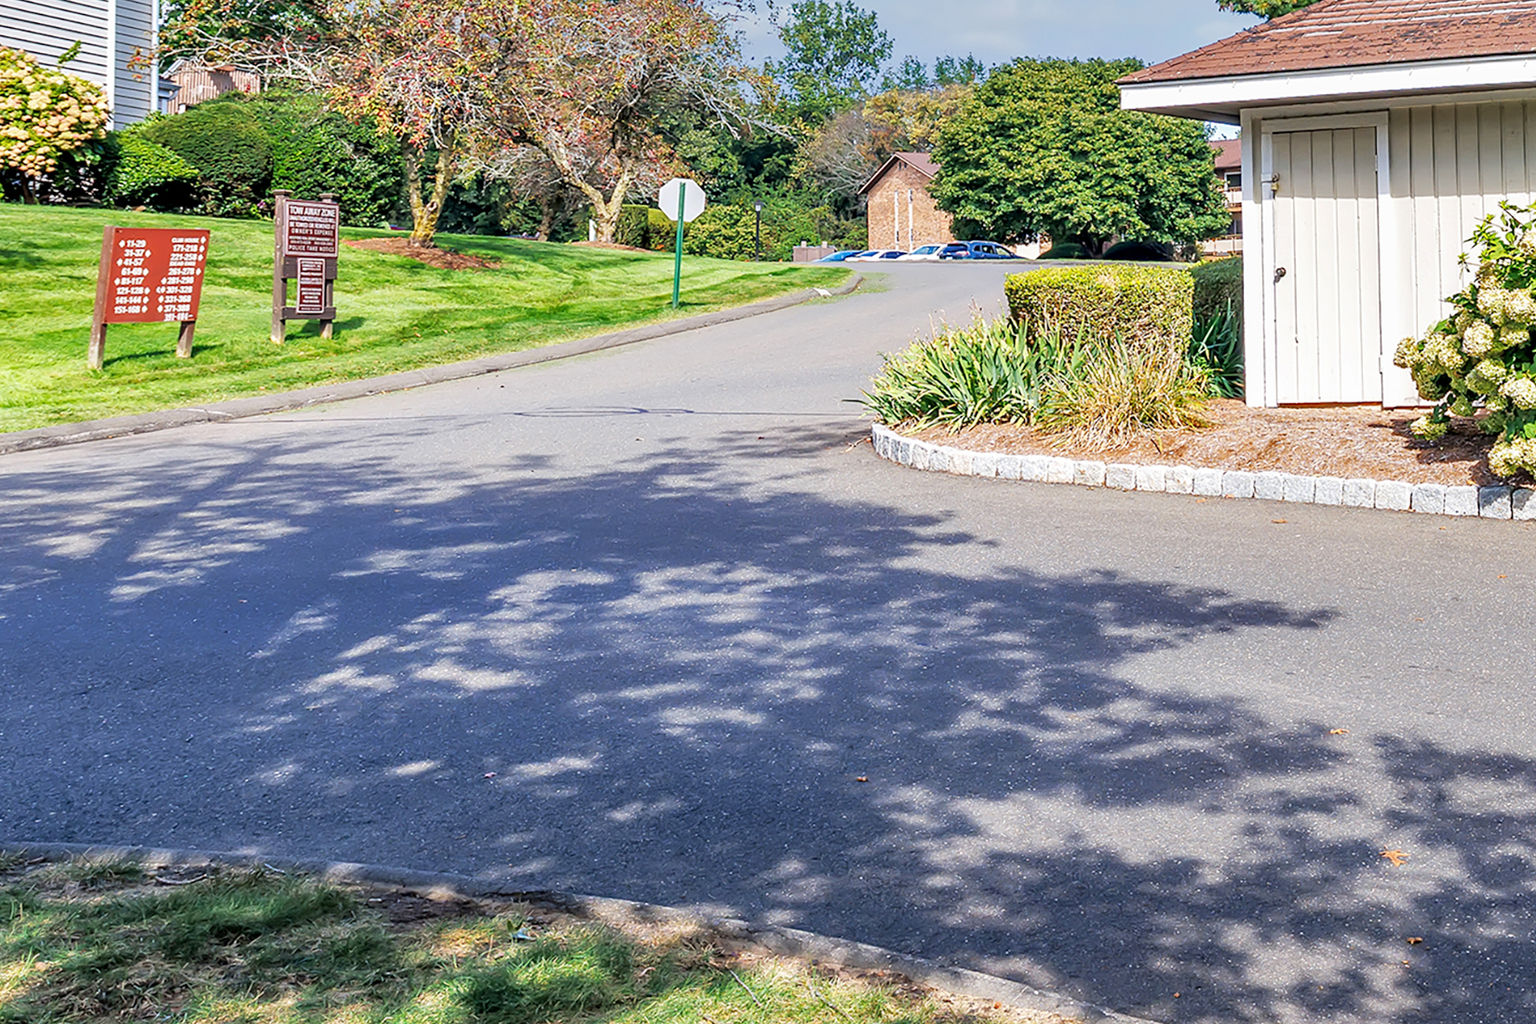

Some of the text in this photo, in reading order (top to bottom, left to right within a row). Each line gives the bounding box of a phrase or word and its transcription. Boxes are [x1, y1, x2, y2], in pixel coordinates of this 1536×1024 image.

[290, 206, 335, 217] TOW AWAY ZONE
[126, 239, 146, 248] 11-29
[124, 249, 145, 257] 31-37
[123, 258, 144, 266] 41-57
[115, 296, 142, 304] 141-144
